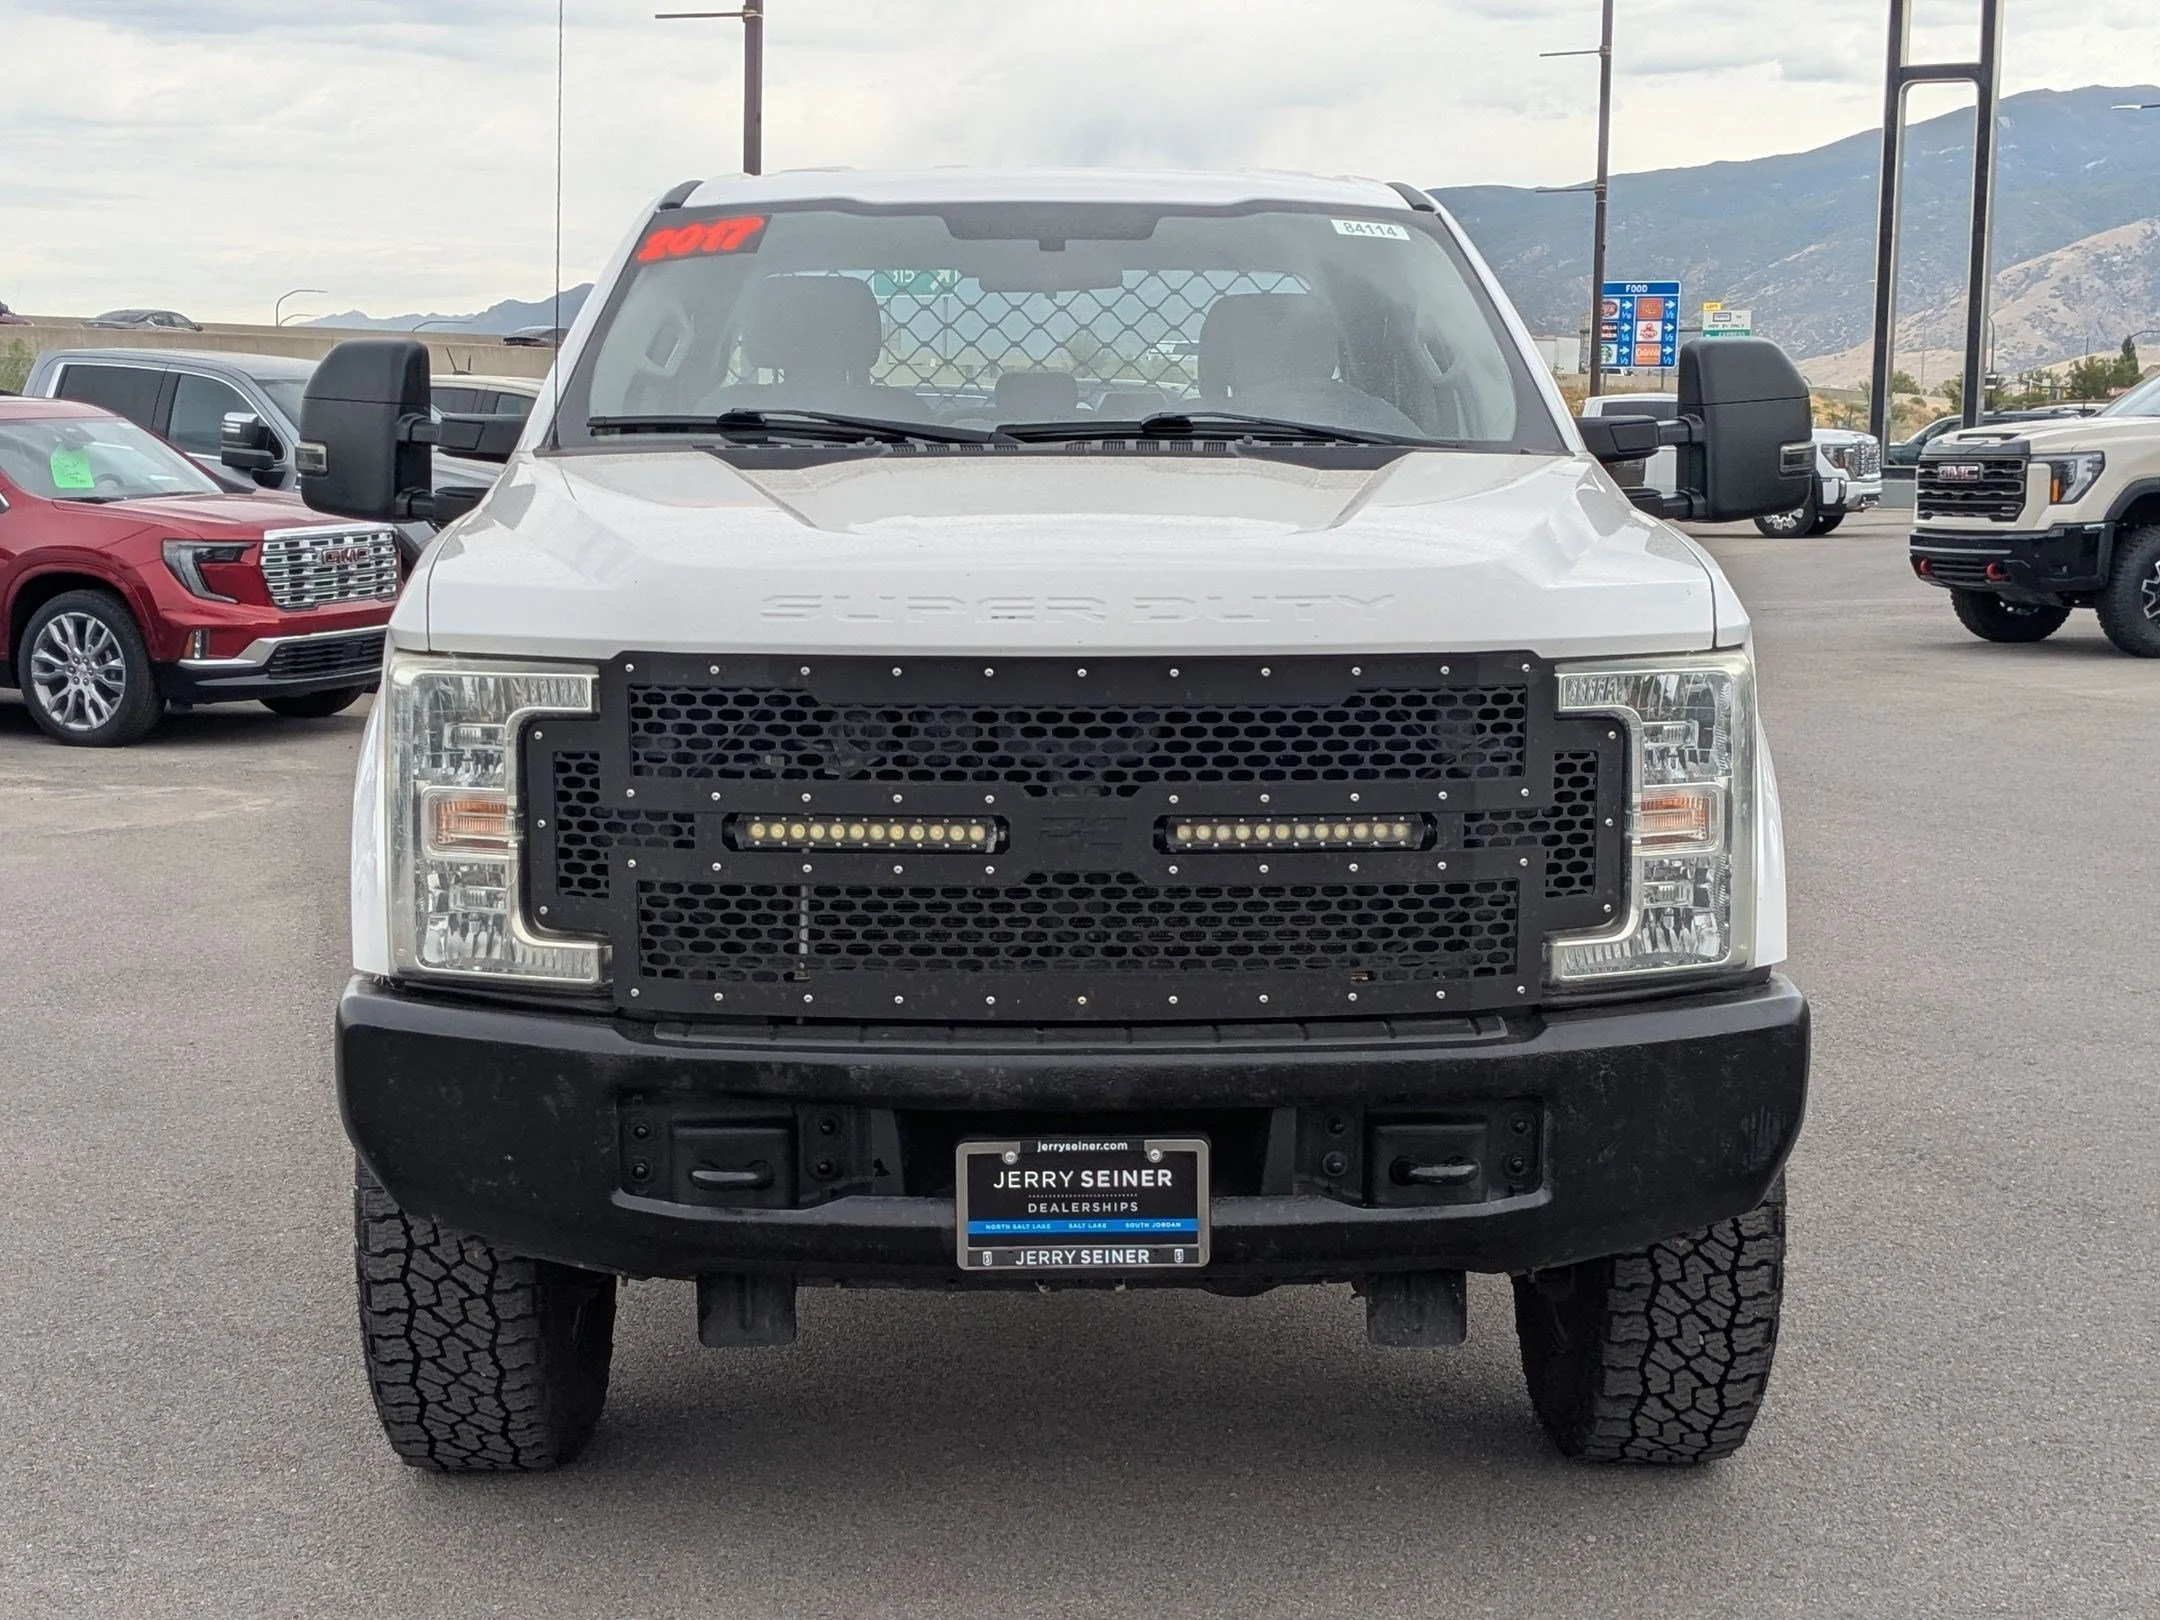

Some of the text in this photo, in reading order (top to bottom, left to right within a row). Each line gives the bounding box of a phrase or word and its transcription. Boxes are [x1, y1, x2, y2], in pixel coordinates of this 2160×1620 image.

[1343, 222, 1397, 237] 84114
[637, 216, 764, 263] 2017
[1625, 284, 1648, 293] FOOD
[1938, 465, 1979, 481] GMC
[324, 549, 370, 563] GMC
[761, 594, 1396, 623] SUPER DUTY
[1037, 1140, 1128, 1152] jerryseiner.com
[993, 1169, 1173, 1189] JERRY SEINER
[1028, 1202, 1139, 1213] DEALERSHIPS
[1015, 1249, 1150, 1265] JERRY SEINER
